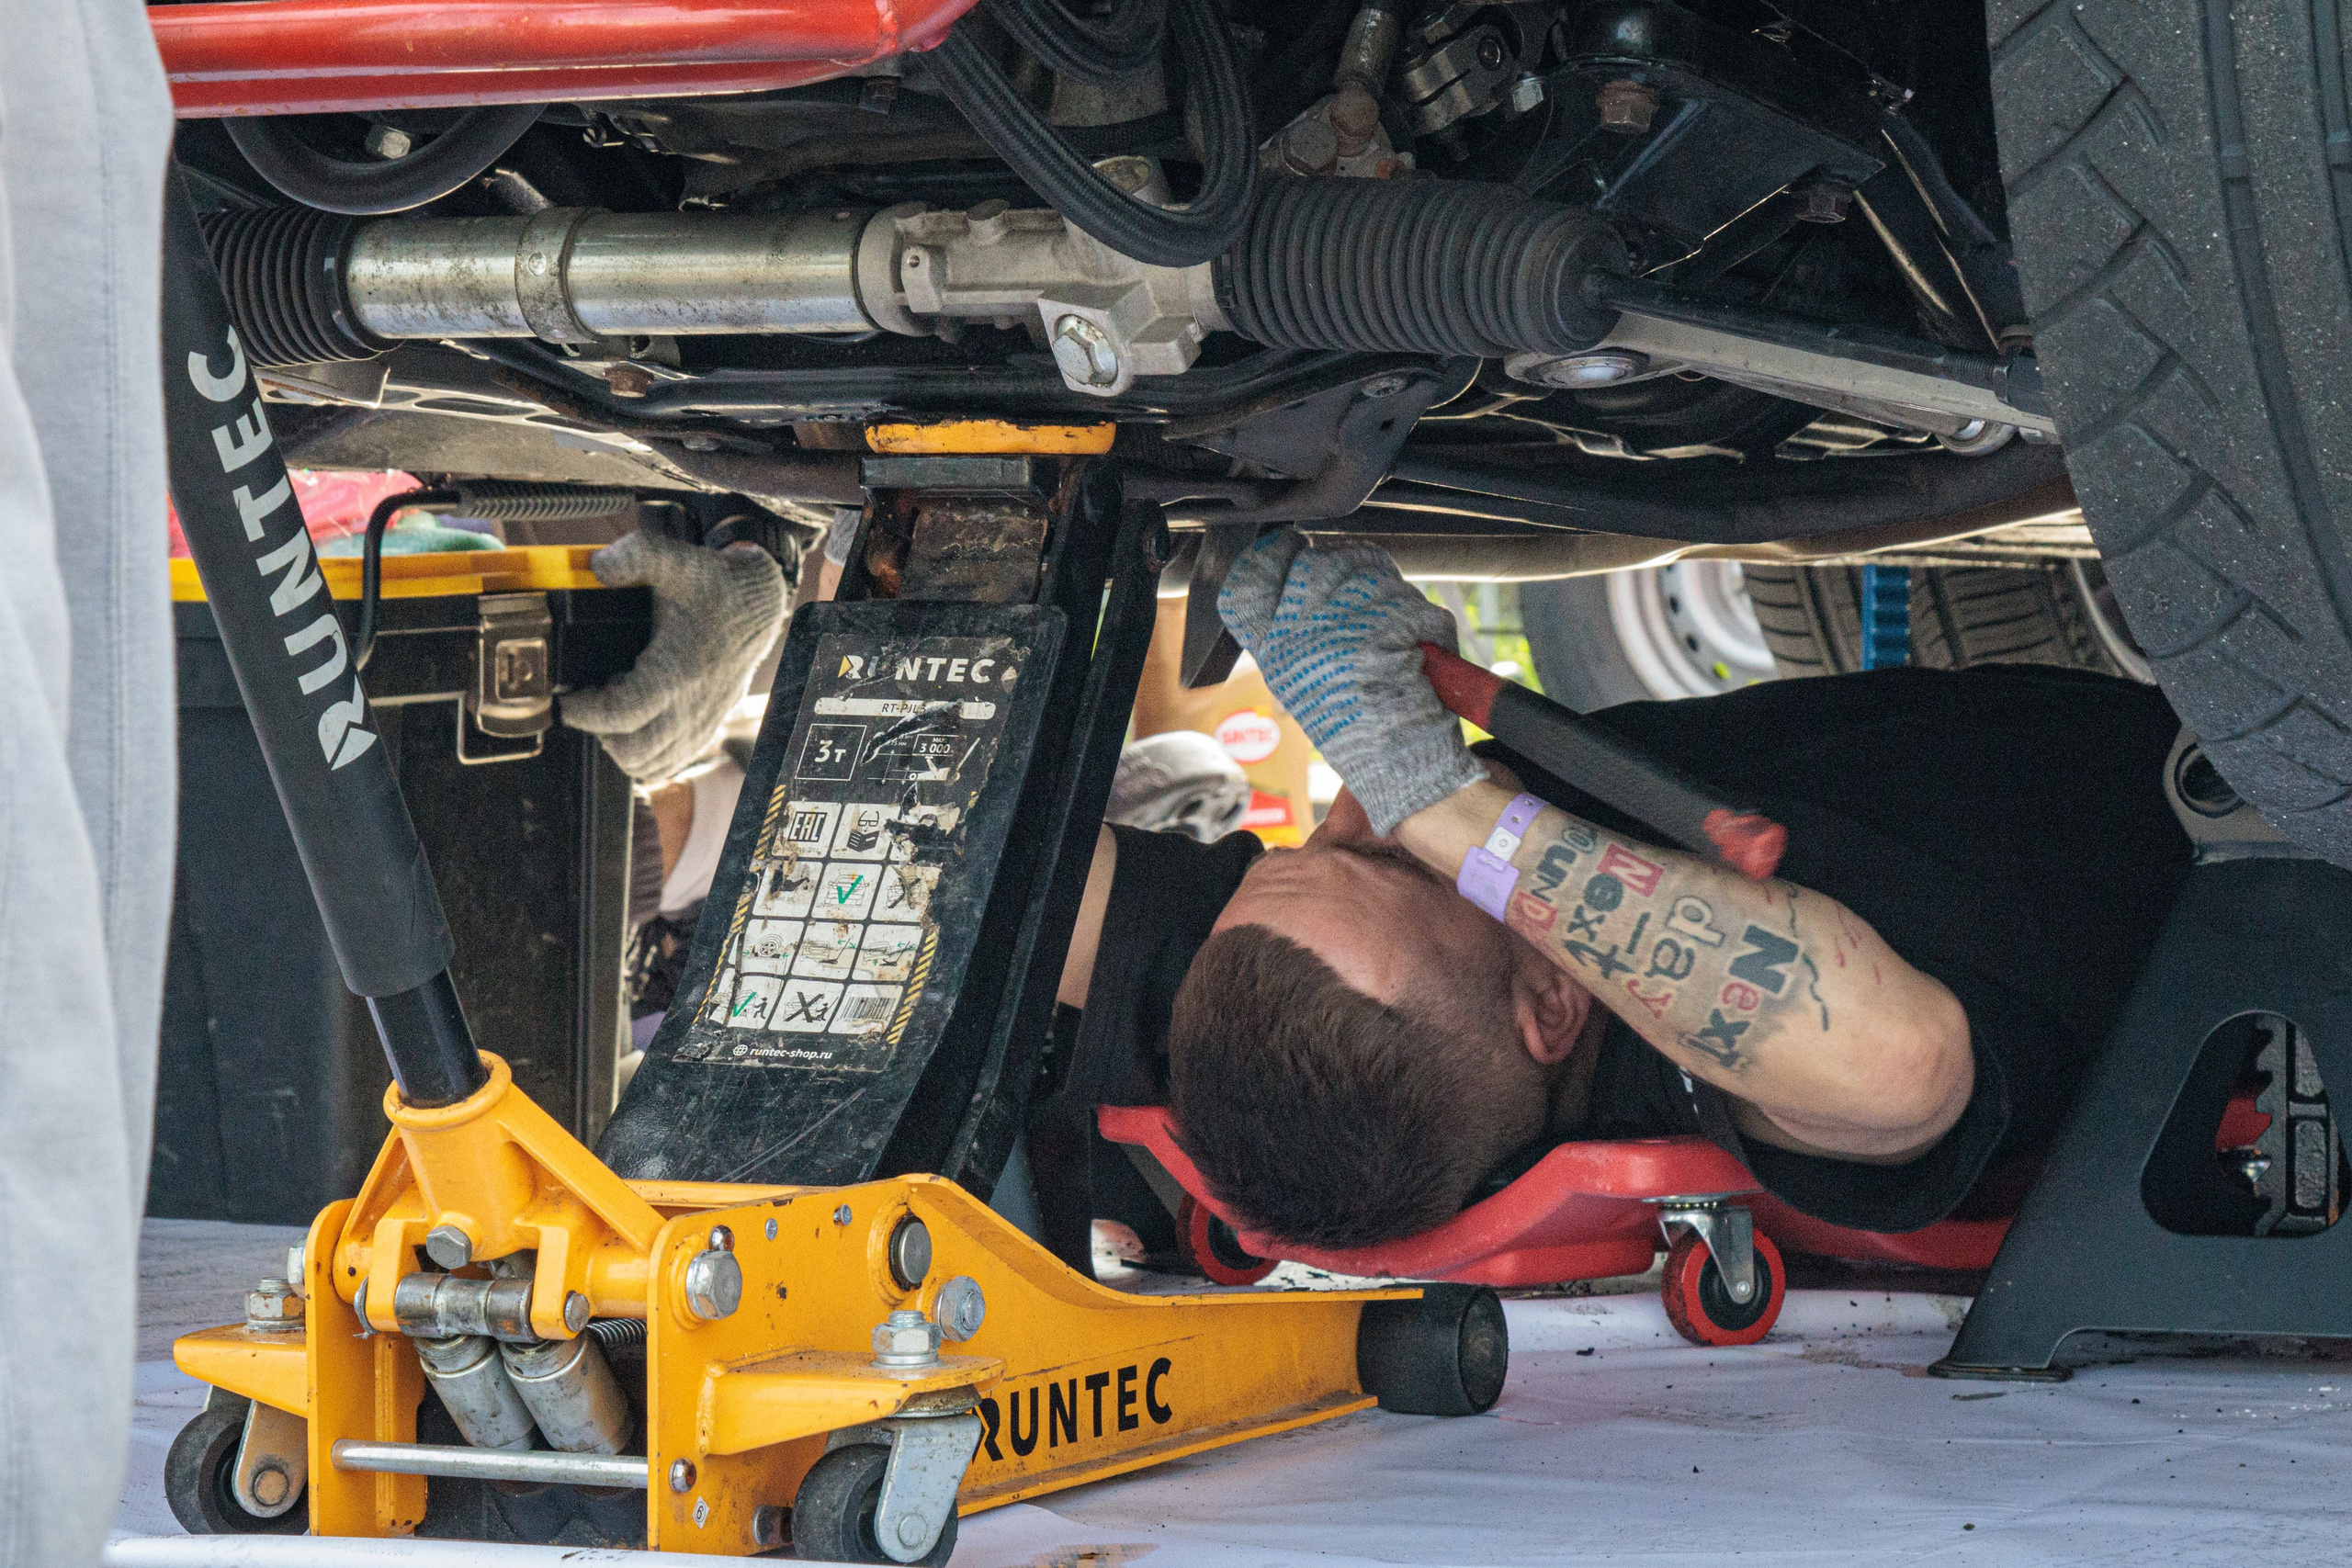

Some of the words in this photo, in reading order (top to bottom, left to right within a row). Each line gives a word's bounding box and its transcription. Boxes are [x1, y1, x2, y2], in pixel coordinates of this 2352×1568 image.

[188, 324, 377, 770] RUNTEC
[1625, 895, 1727, 1019] day
[1679, 924, 1802, 1069] Next
[749, 1047, 833, 1060] runtec-shop.ru
[972, 1357, 1172, 1464] RUNTEC
